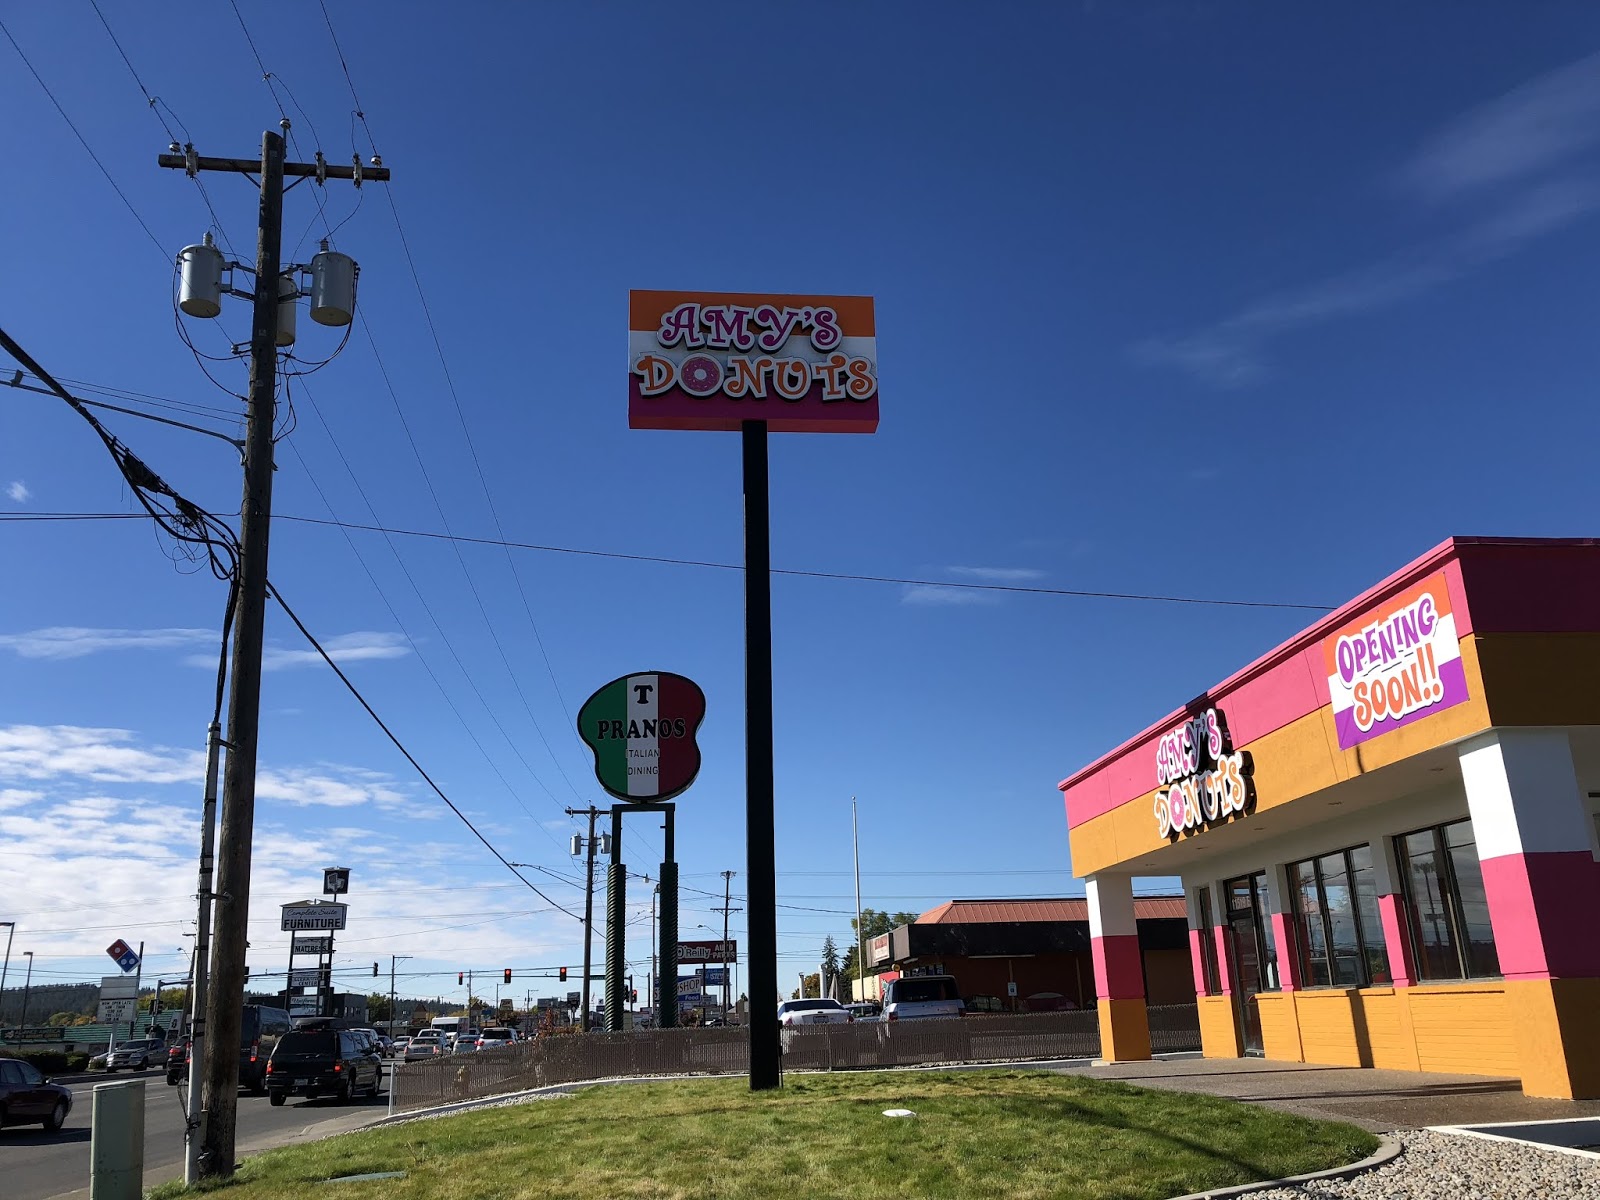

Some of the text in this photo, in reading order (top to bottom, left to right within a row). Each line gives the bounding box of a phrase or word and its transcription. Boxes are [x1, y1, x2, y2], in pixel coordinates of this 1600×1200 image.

[658, 304, 842, 350] AMY'S
[634, 354, 877, 400] DONUTS
[1338, 597, 1436, 684] OPENING
[633, 684, 654, 705] T
[1353, 643, 1441, 727] SOON!!
[597, 718, 686, 740] PRANOS
[1156, 708, 1222, 785] AMY'S
[627, 766, 659, 776] DINING
[1154, 754, 1245, 839] DONUTS
[284, 918, 341, 929] FURNITURE
